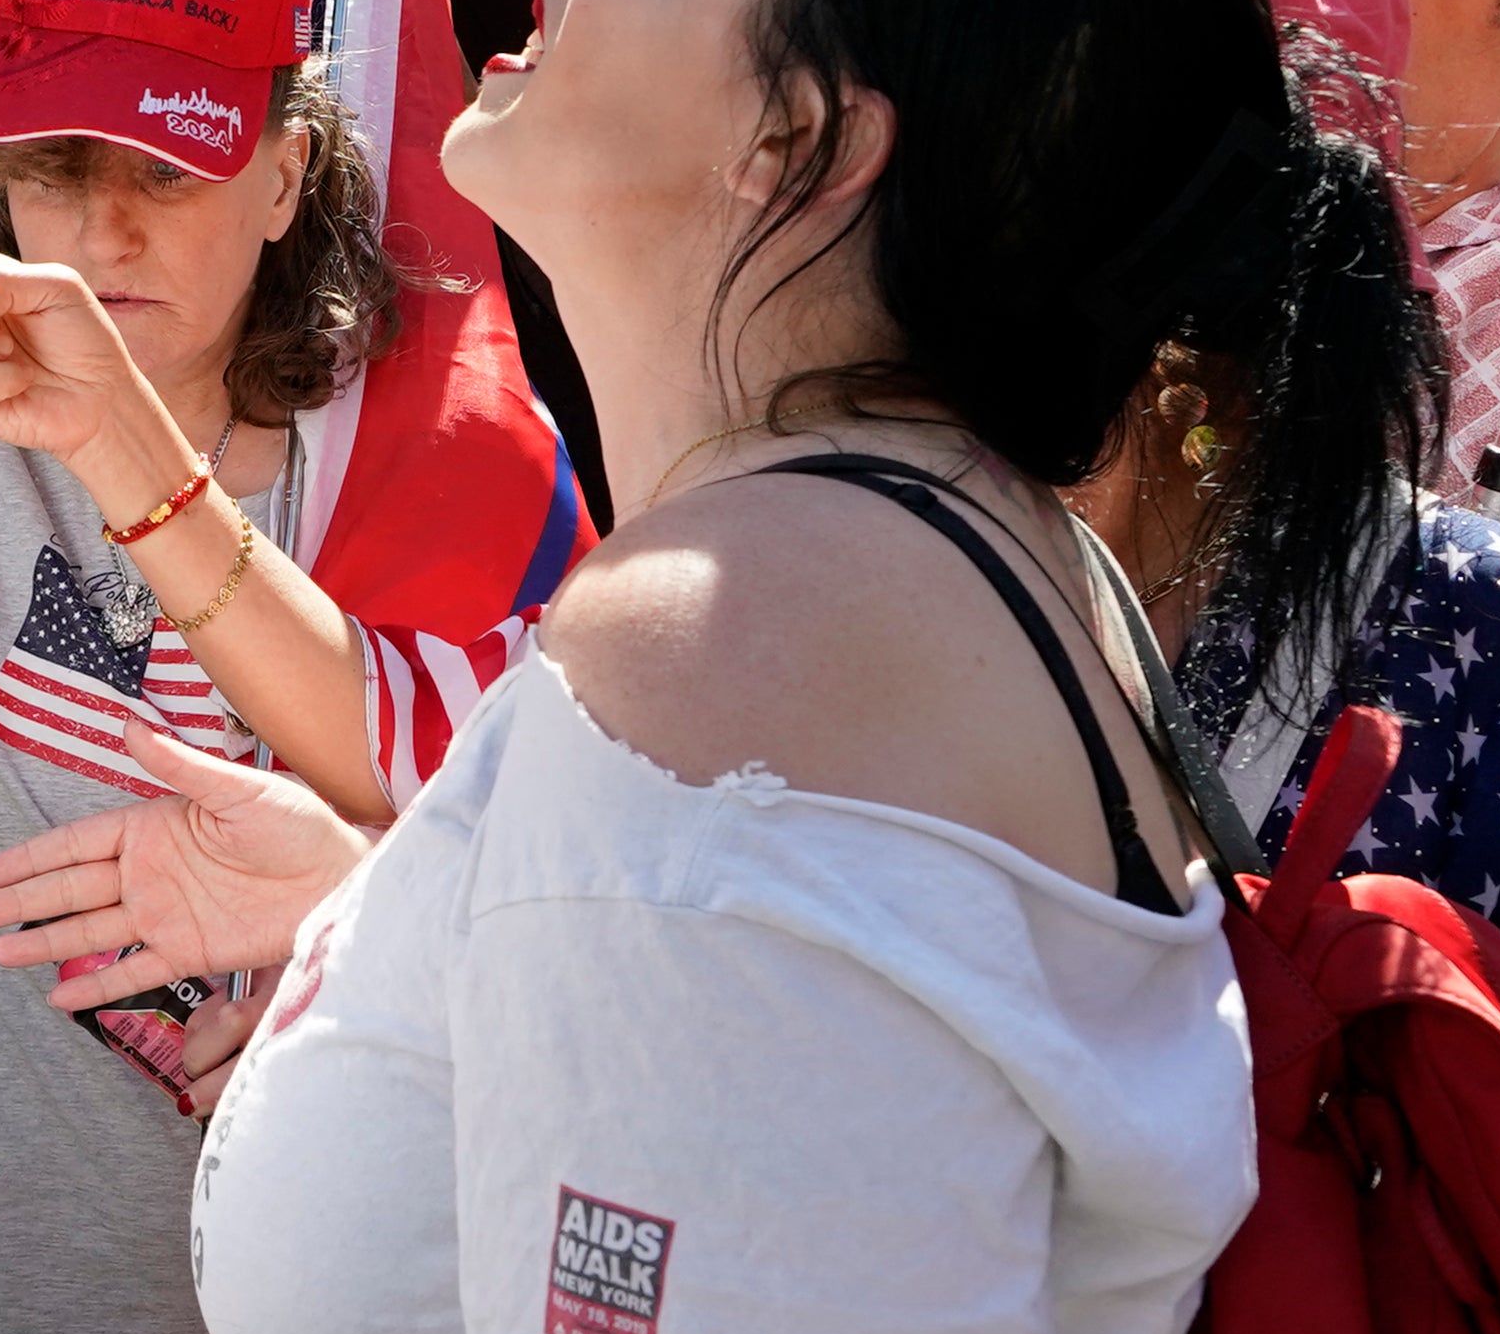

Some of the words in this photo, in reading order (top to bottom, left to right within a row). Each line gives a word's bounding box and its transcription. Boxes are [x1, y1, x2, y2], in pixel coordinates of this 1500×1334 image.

[184, 0, 239, 34] BACK!
[165, 113, 233, 156] 2024
[560, 1197, 665, 1264] AIDS
[556, 1233, 657, 1297] WALK
[552, 1267, 595, 1299] NEW
[600, 1282, 654, 1318] YORK
[552, 1291, 584, 1318] MAY
